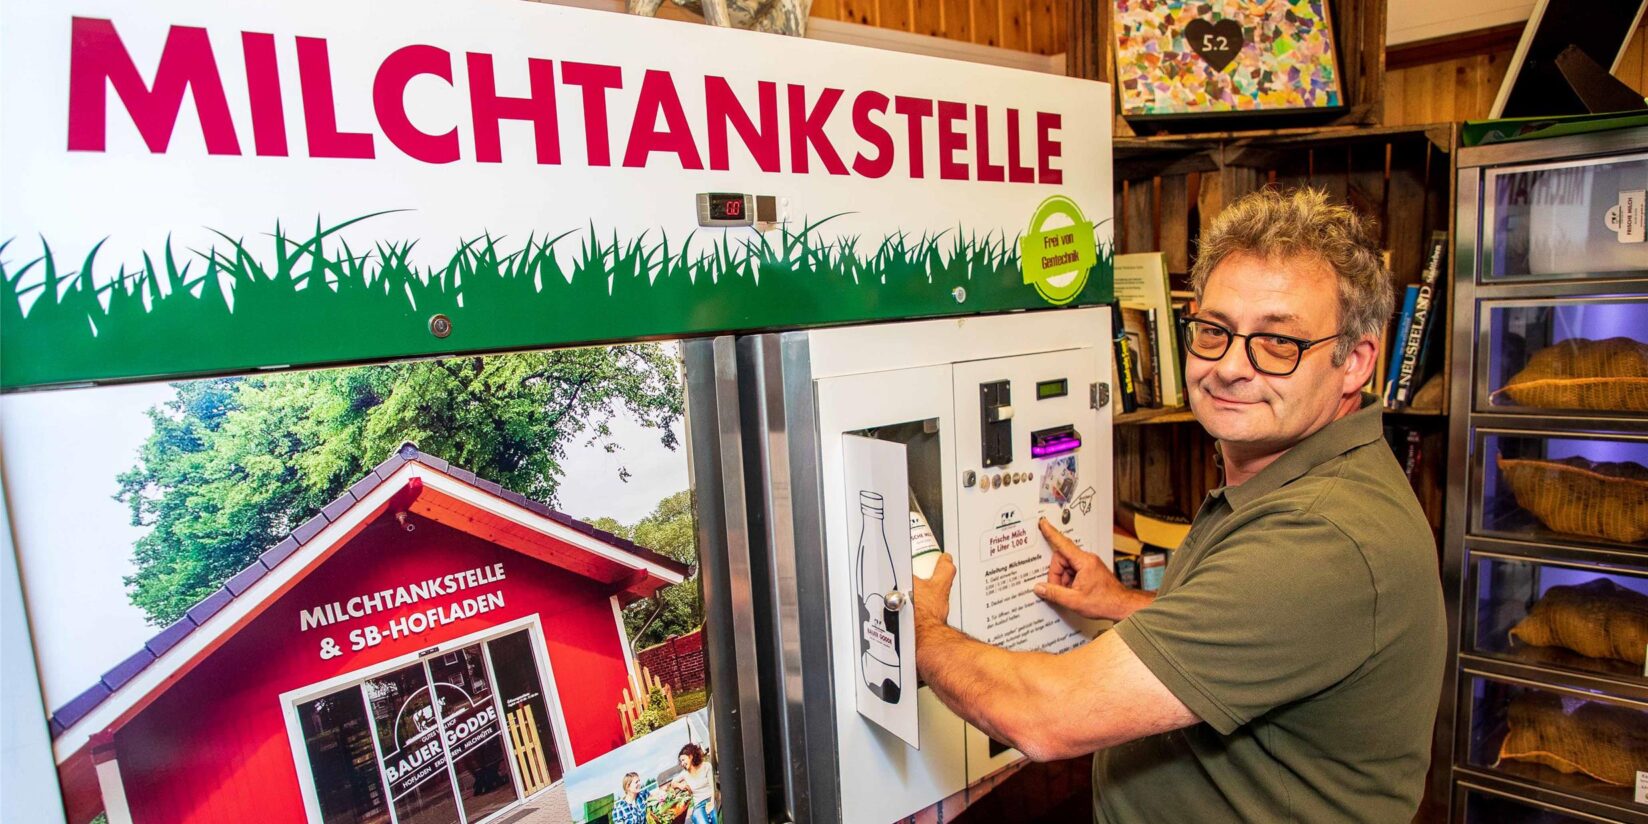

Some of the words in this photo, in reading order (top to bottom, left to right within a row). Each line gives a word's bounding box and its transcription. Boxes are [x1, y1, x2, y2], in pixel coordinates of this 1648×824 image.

[1202, 34, 1230, 52] 5.2
[67, 16, 1063, 184] MILCHTANKSTELLE
[1044, 234, 1059, 249] Frei
[1061, 233, 1074, 246] von
[1041, 250, 1080, 270] Gentechnik
[1399, 285, 1432, 386] NEUSEELAND
[989, 534, 1010, 546] Frische
[1011, 528, 1027, 539] Milch
[989, 546, 996, 556] je
[997, 543, 1009, 553] Liter
[300, 562, 506, 632] MILCHTANKSTELLE
[318, 636, 343, 660] &
[349, 591, 506, 652] SB-HOFLADEN
[386, 740, 443, 783] BAUER
[445, 706, 497, 746] GODDE
[402, 766, 432, 788] HOFLADEN
